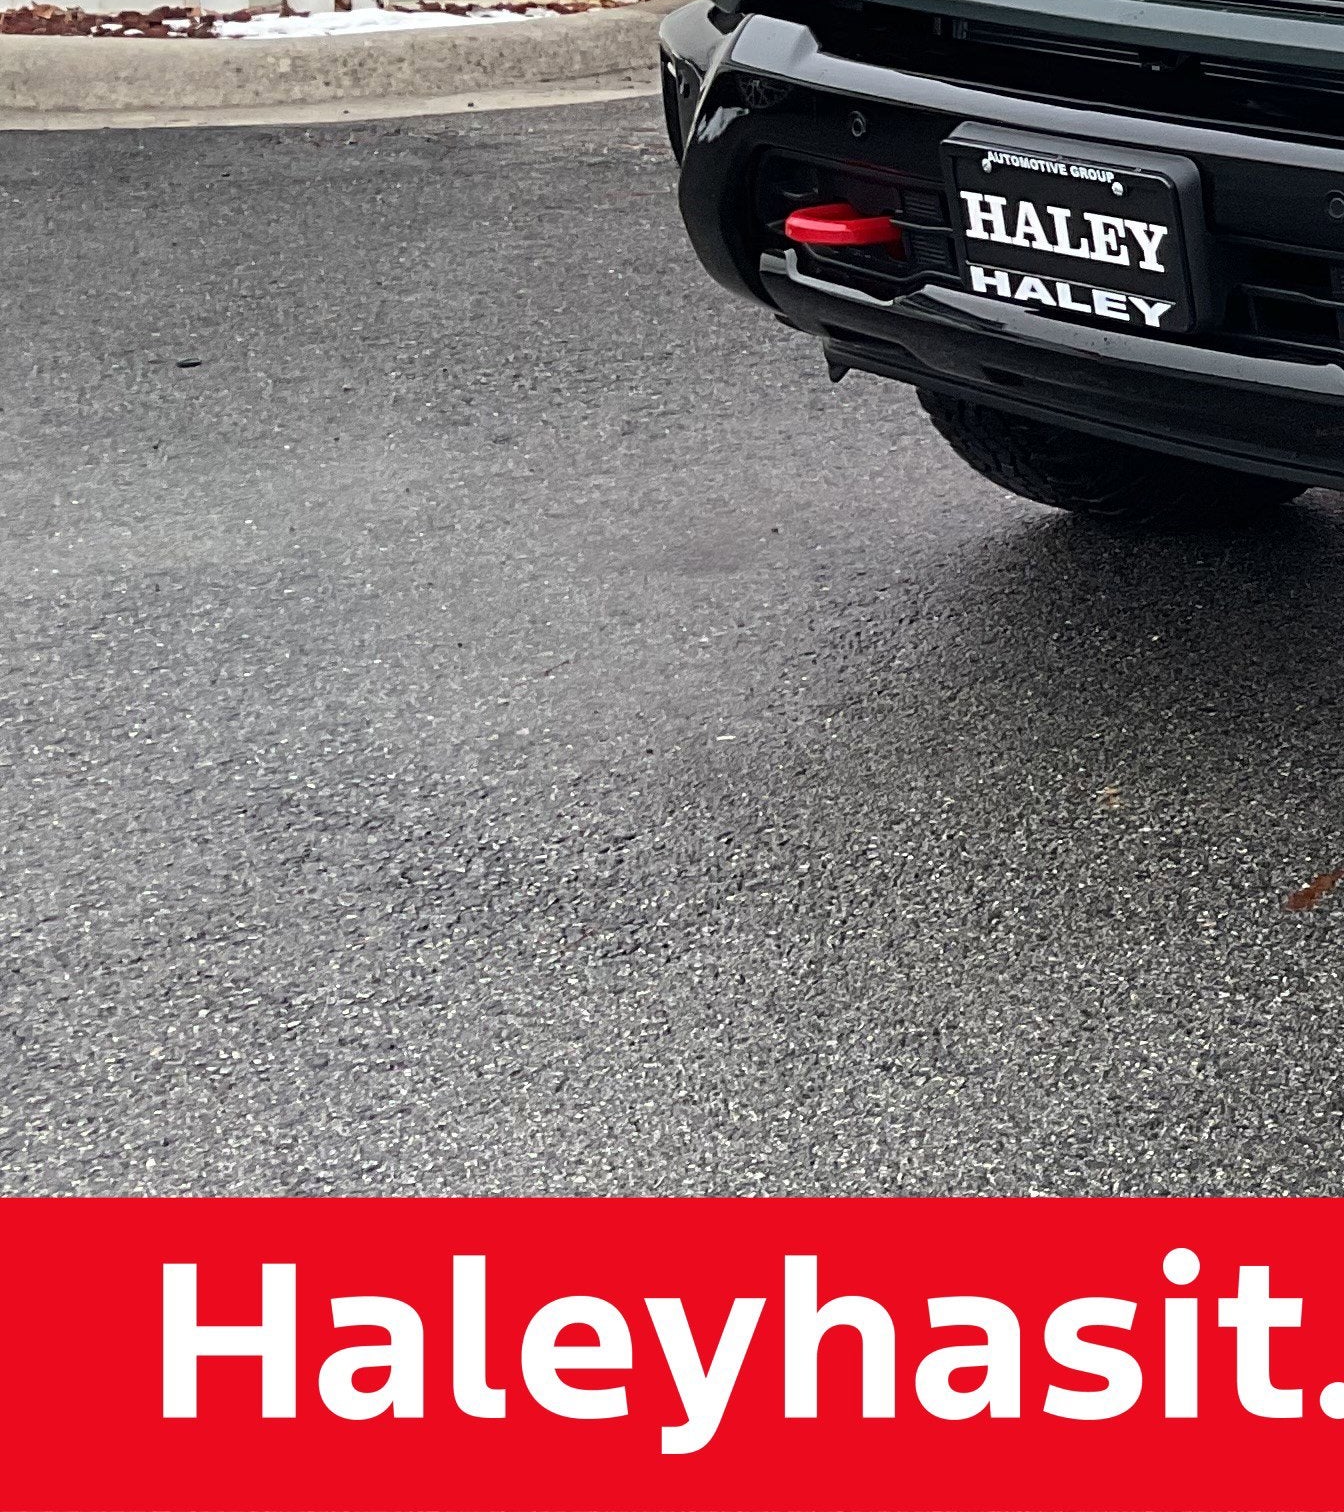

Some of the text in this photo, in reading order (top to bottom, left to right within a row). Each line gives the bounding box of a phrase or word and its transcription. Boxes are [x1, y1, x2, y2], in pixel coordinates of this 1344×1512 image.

[987, 150, 1115, 184] AUTOMOTIVE GROUP
[960, 190, 1168, 273] HALEY
[970, 265, 1172, 328] HALEY
